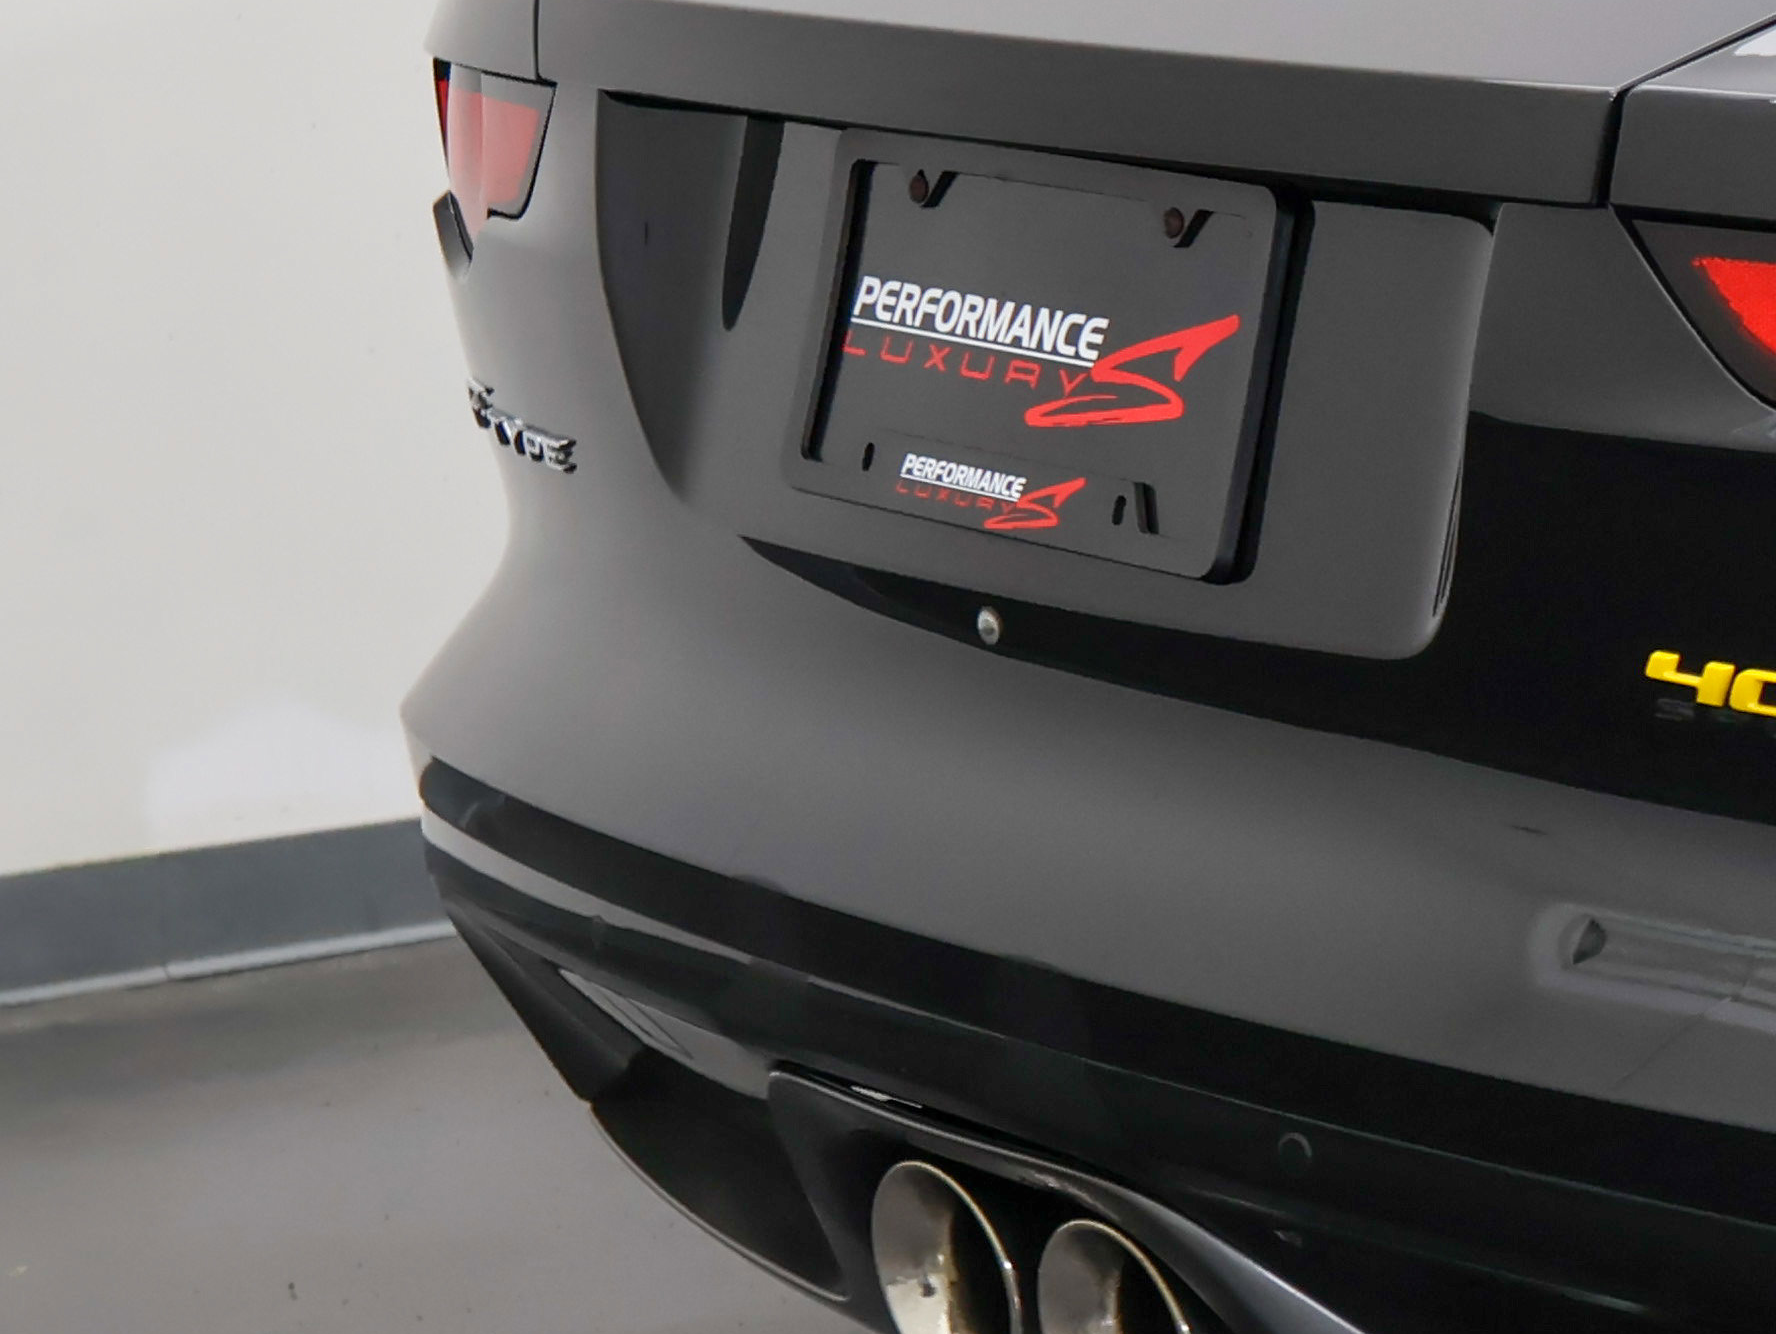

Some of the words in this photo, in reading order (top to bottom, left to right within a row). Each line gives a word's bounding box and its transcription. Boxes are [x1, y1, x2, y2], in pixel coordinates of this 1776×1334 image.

[852, 275, 1109, 362] PERFORMANCE
[842, 329, 1088, 397] LUXURY
[896, 480, 1016, 513] LUXURY
[901, 453, 1027, 499] PERFORMANCE
